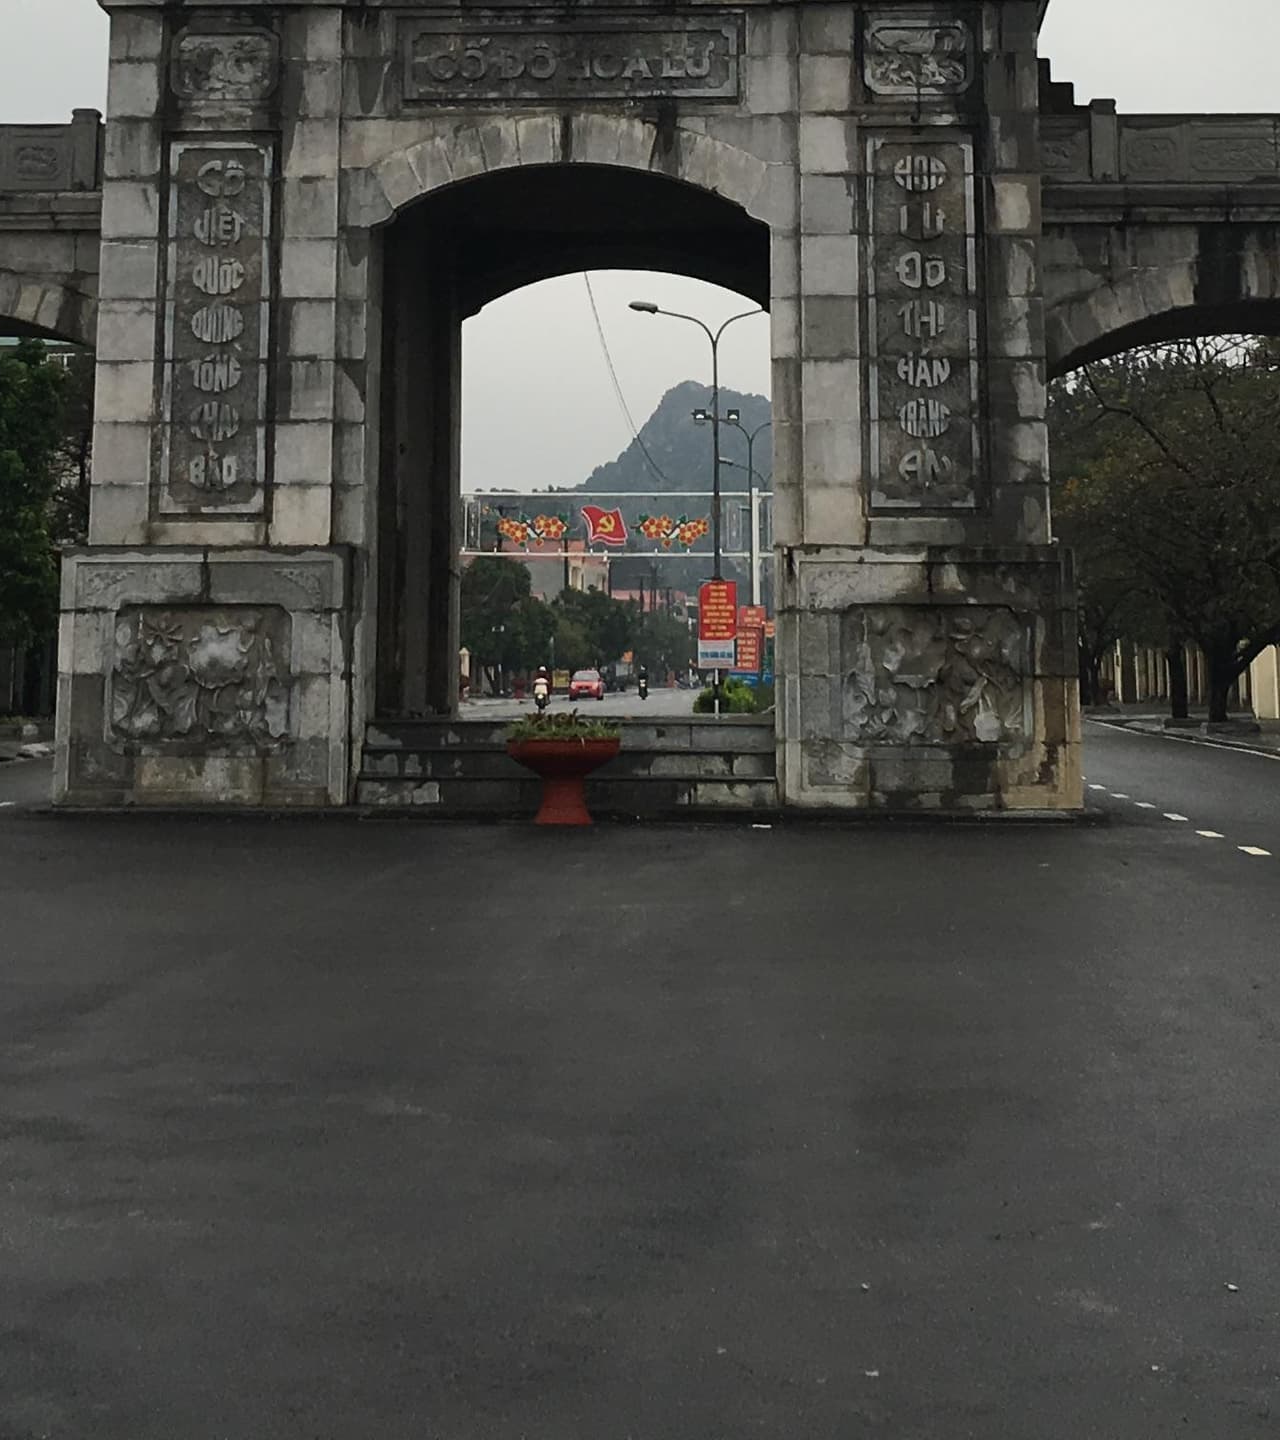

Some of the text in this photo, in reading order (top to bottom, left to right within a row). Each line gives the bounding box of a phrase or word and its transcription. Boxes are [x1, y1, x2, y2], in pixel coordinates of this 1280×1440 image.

[659, 40, 714, 81] LƯ
[892, 154, 947, 192] HOA
[897, 201, 946, 241] LƯ
[191, 255, 246, 297] QUỐC
[894, 250, 946, 289] ĐÔ
[894, 299, 945, 338] THỊ
